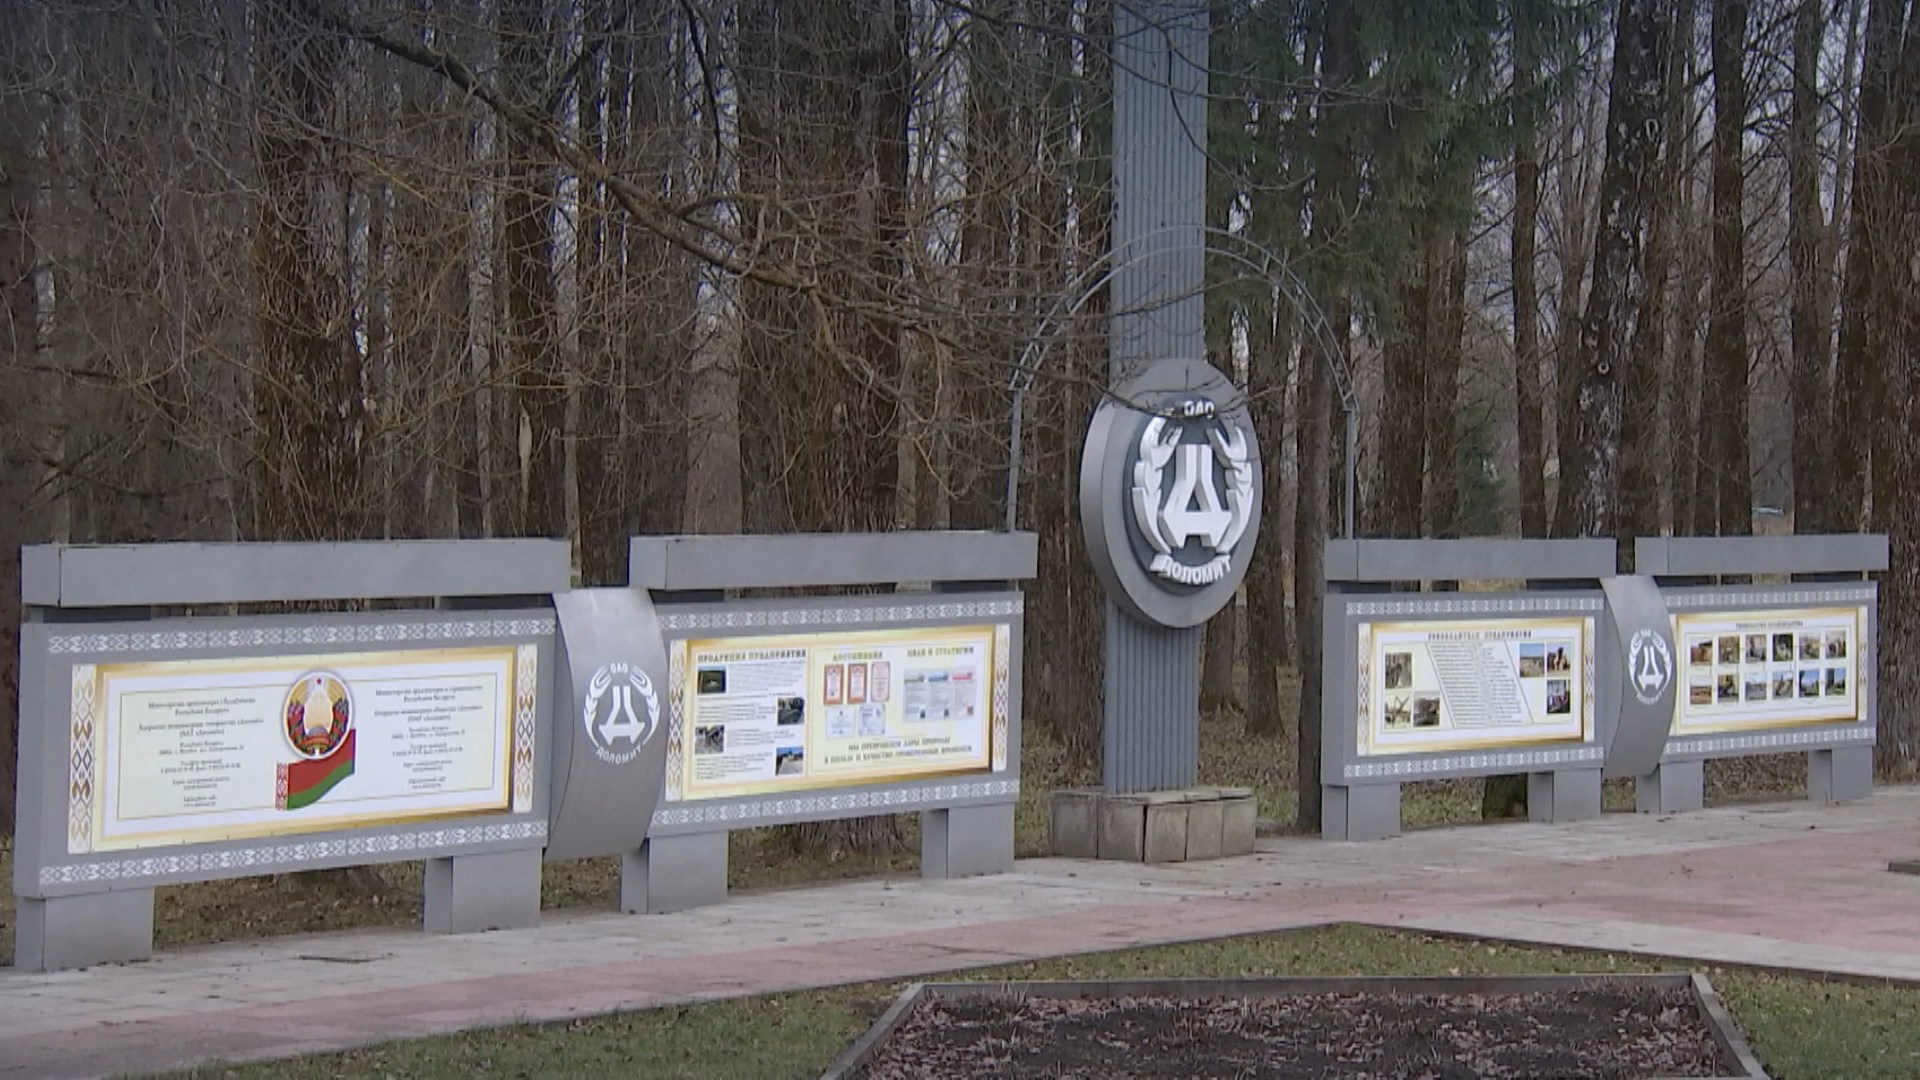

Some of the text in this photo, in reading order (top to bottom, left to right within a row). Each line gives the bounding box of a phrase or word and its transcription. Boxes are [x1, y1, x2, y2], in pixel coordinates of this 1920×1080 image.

[1184, 399, 1215, 419] ОАО
[1154, 553, 1232, 585] ДОЛОМИТ
[610, 662, 628, 674] ОАО
[596, 743, 641, 765] ДОЛОМИТ
